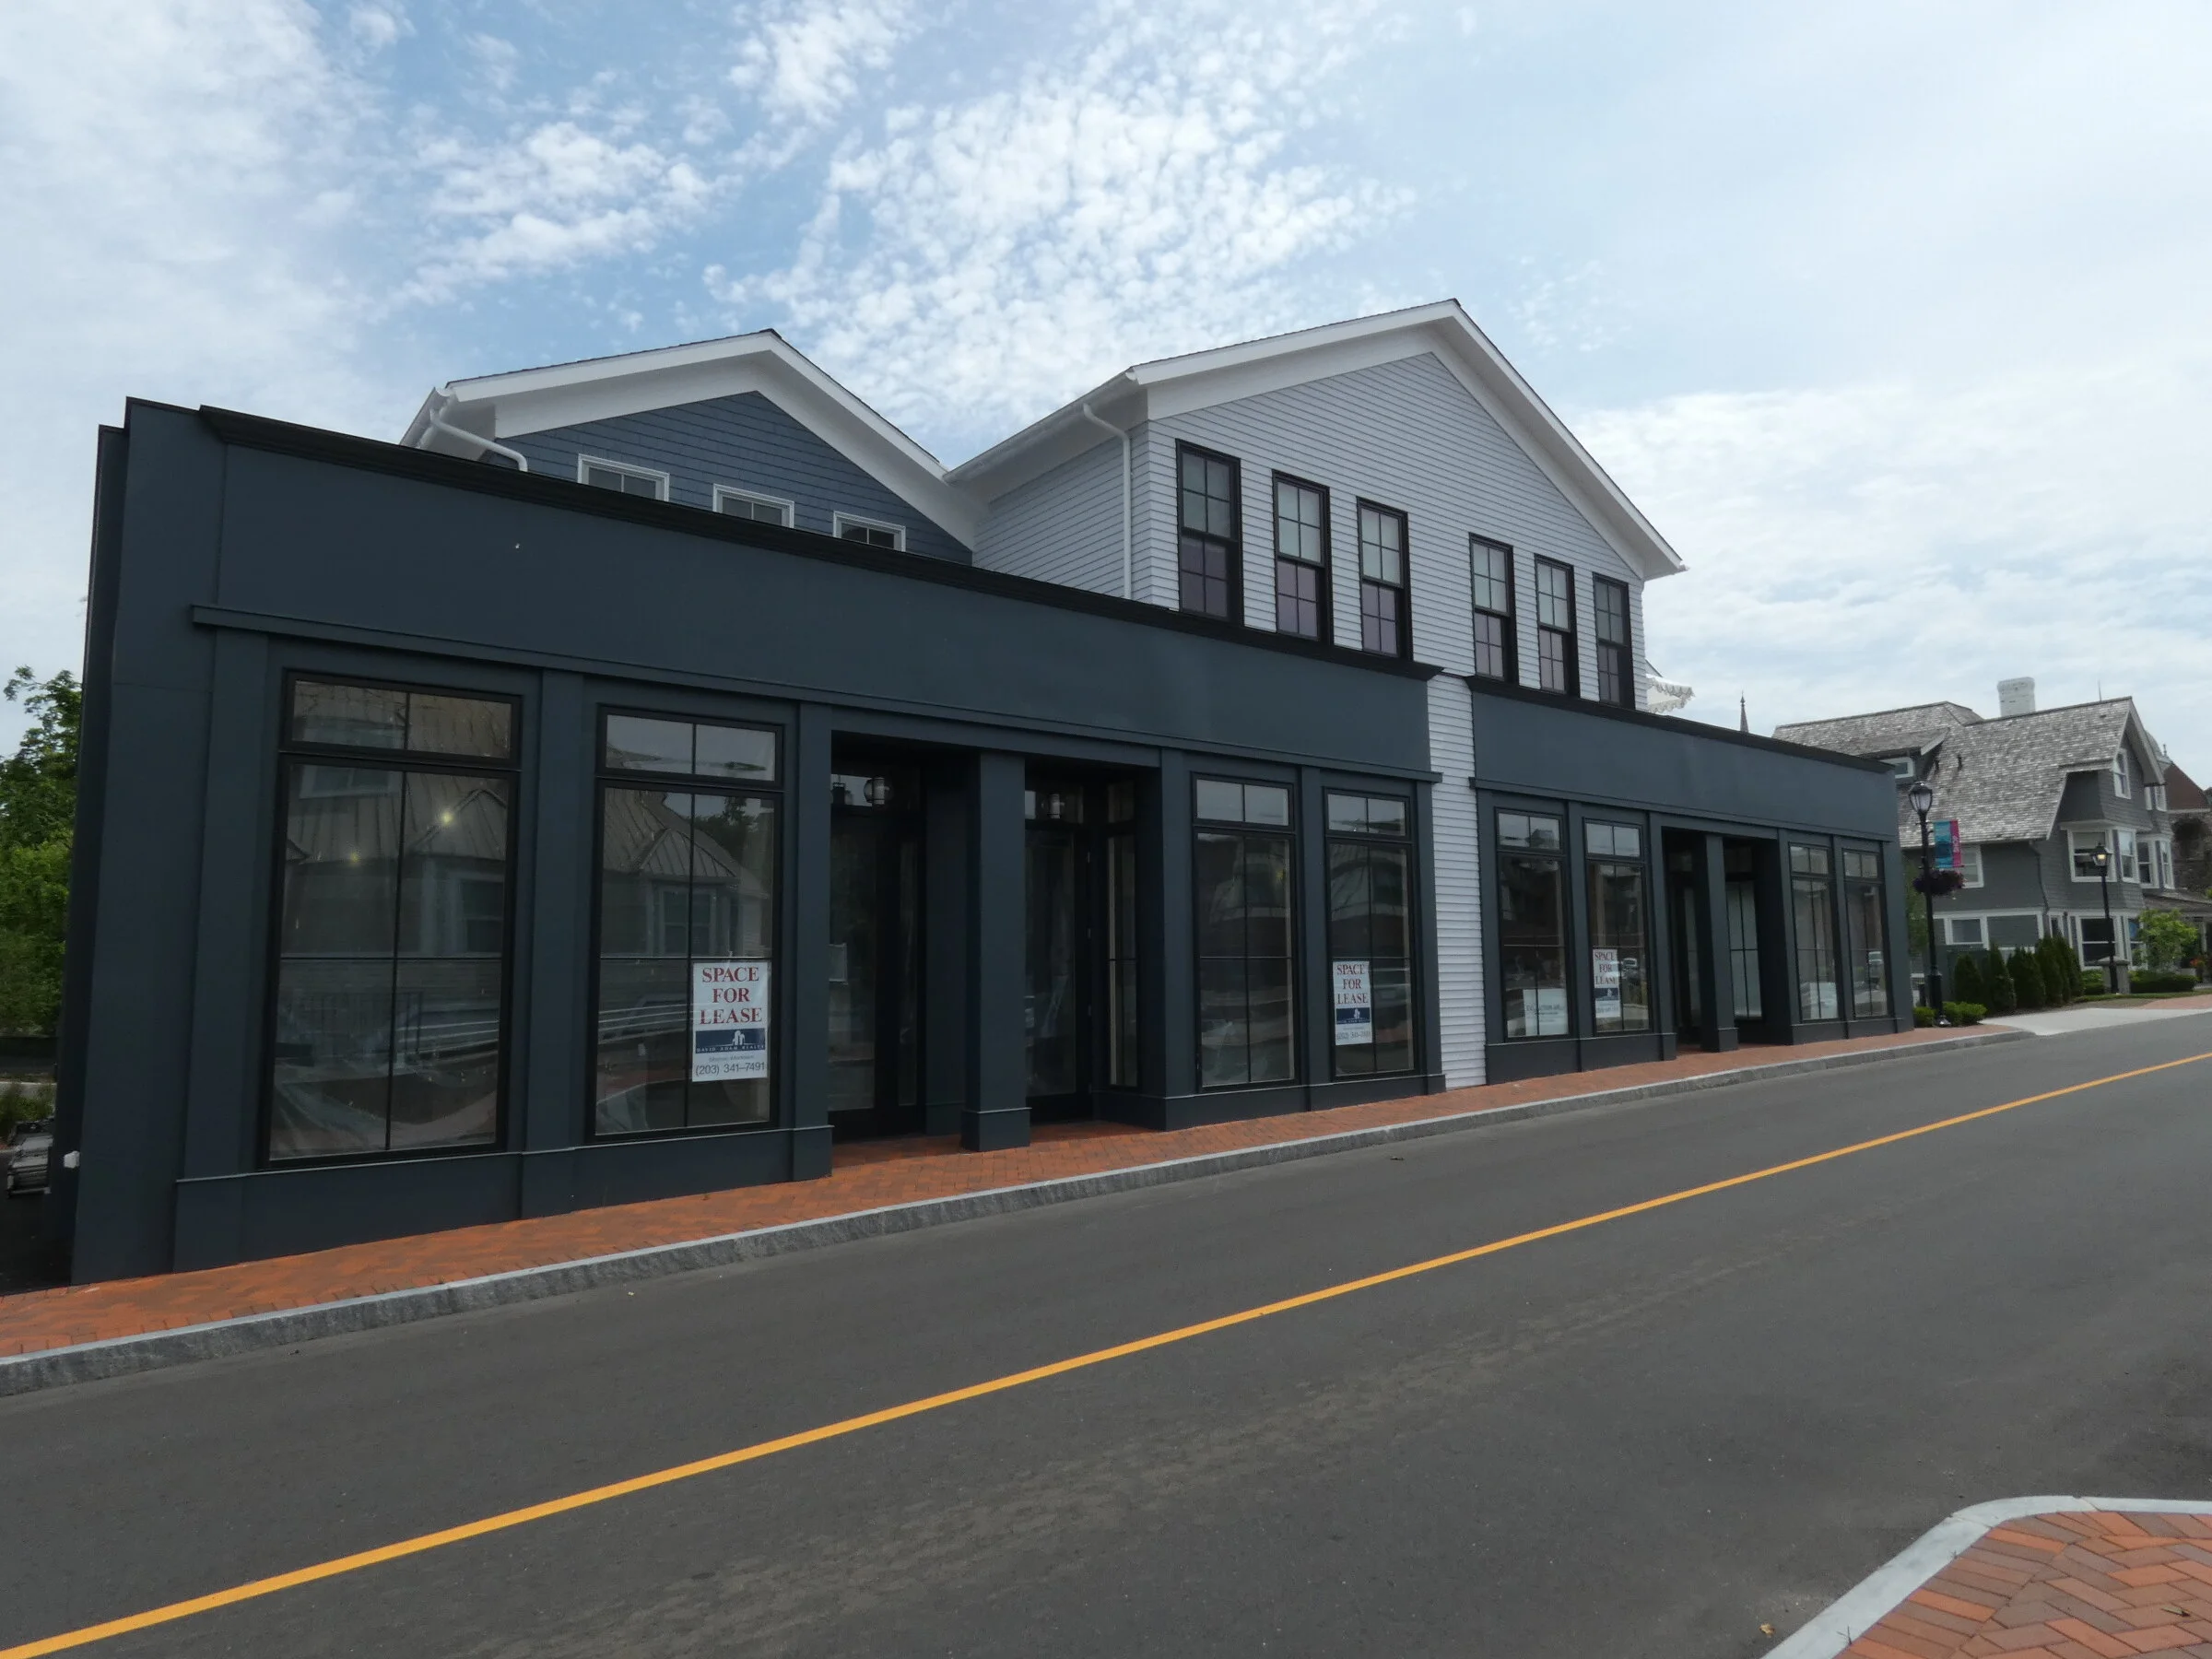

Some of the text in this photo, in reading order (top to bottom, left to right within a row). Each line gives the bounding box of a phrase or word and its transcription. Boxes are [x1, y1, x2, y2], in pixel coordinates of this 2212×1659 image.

[1336, 964, 1364, 975] SPACE
[1600, 963, 1612, 972] FOR
[702, 967, 759, 982] SPACE
[1343, 979, 1361, 989] FOR
[712, 988, 750, 1003] FOR
[1337, 994, 1368, 1004] LEASE
[700, 1008, 762, 1024] LEASE
[695, 1064, 720, 1077] (203)
